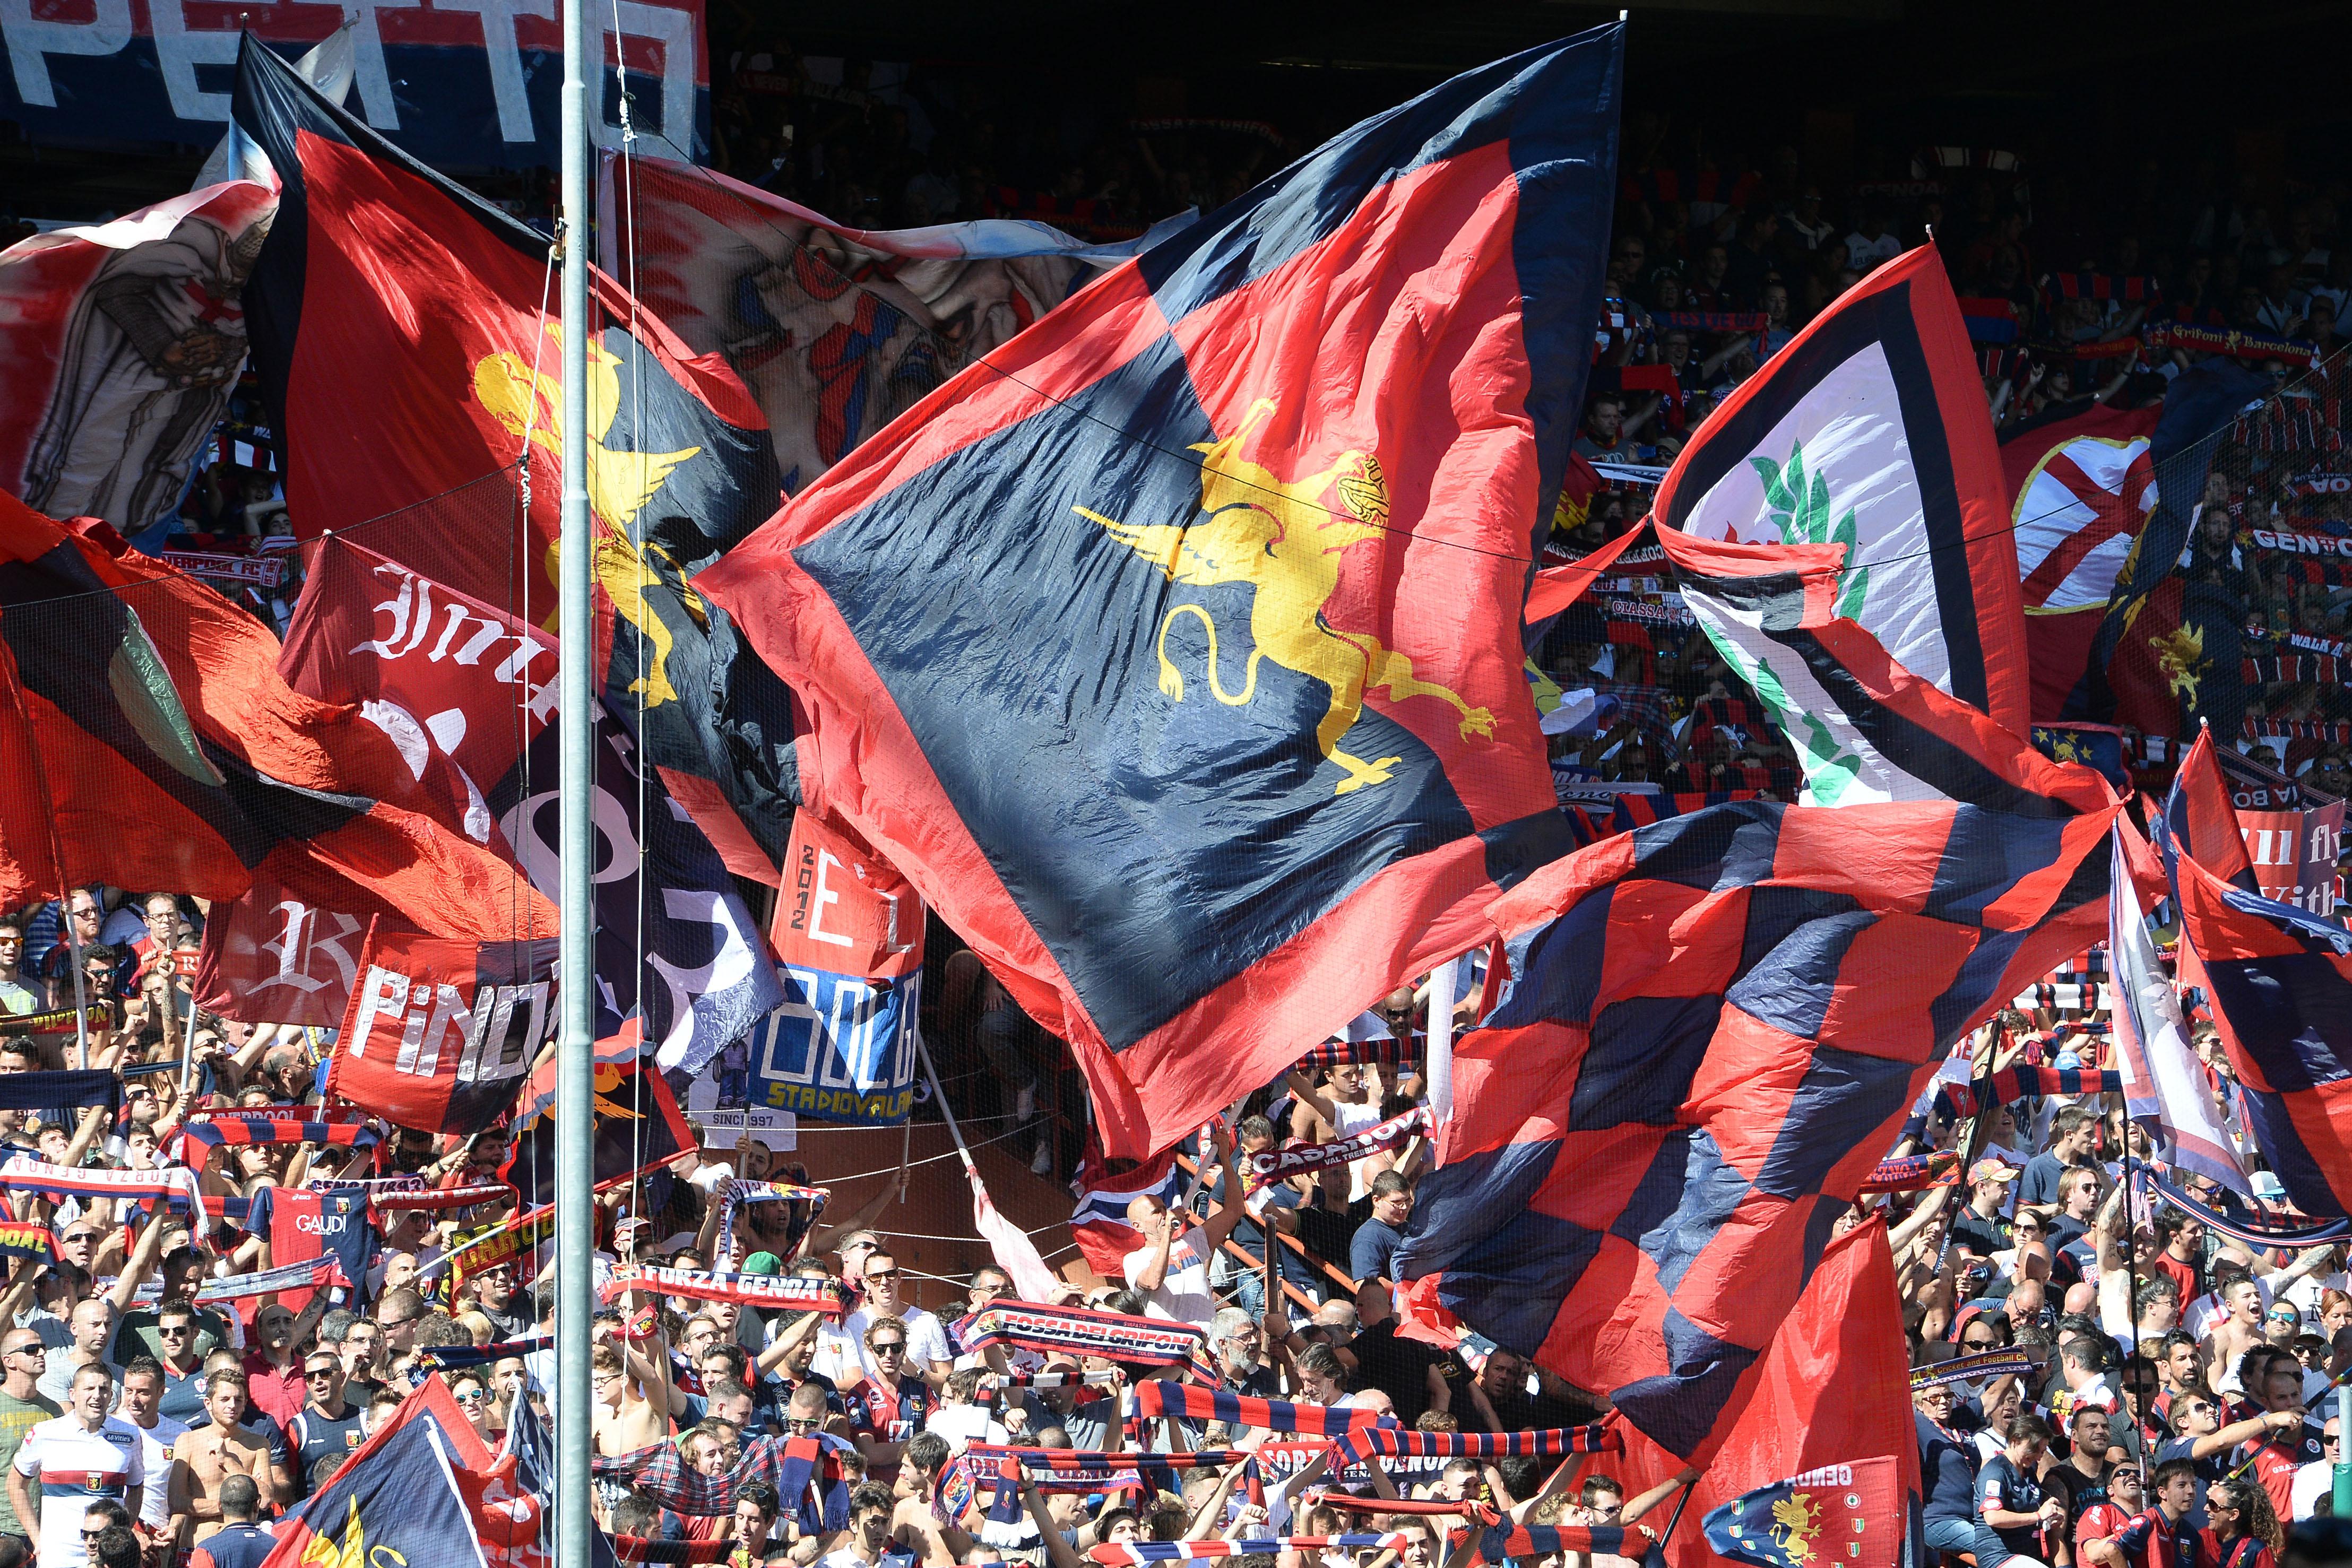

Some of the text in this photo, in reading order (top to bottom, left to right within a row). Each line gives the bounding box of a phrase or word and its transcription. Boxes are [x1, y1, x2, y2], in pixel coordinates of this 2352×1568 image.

[2173, 323, 2312, 357] Grifoni Barcelona
[241, 563, 261, 576] FC
[1612, 600, 1666, 620] CIASSA
[2308, 824, 2341, 868] fly
[791, 844, 814, 930] 2012
[1252, 1106, 1436, 1174] CASANOVA
[1342, 1144, 1380, 1160] TREBBIA
[13, 1156, 173, 1186] FORZA GENOA
[296, 1214, 347, 1233] GAUDI
[645, 1265, 817, 1301] FORZA GENOA
[1002, 1314, 1195, 1353] FOSSA DEI GRIFONI
[1938, 1362, 1964, 1374] Cricket
[1967, 1358, 1981, 1368] and
[1983, 1353, 2013, 1365] Football
